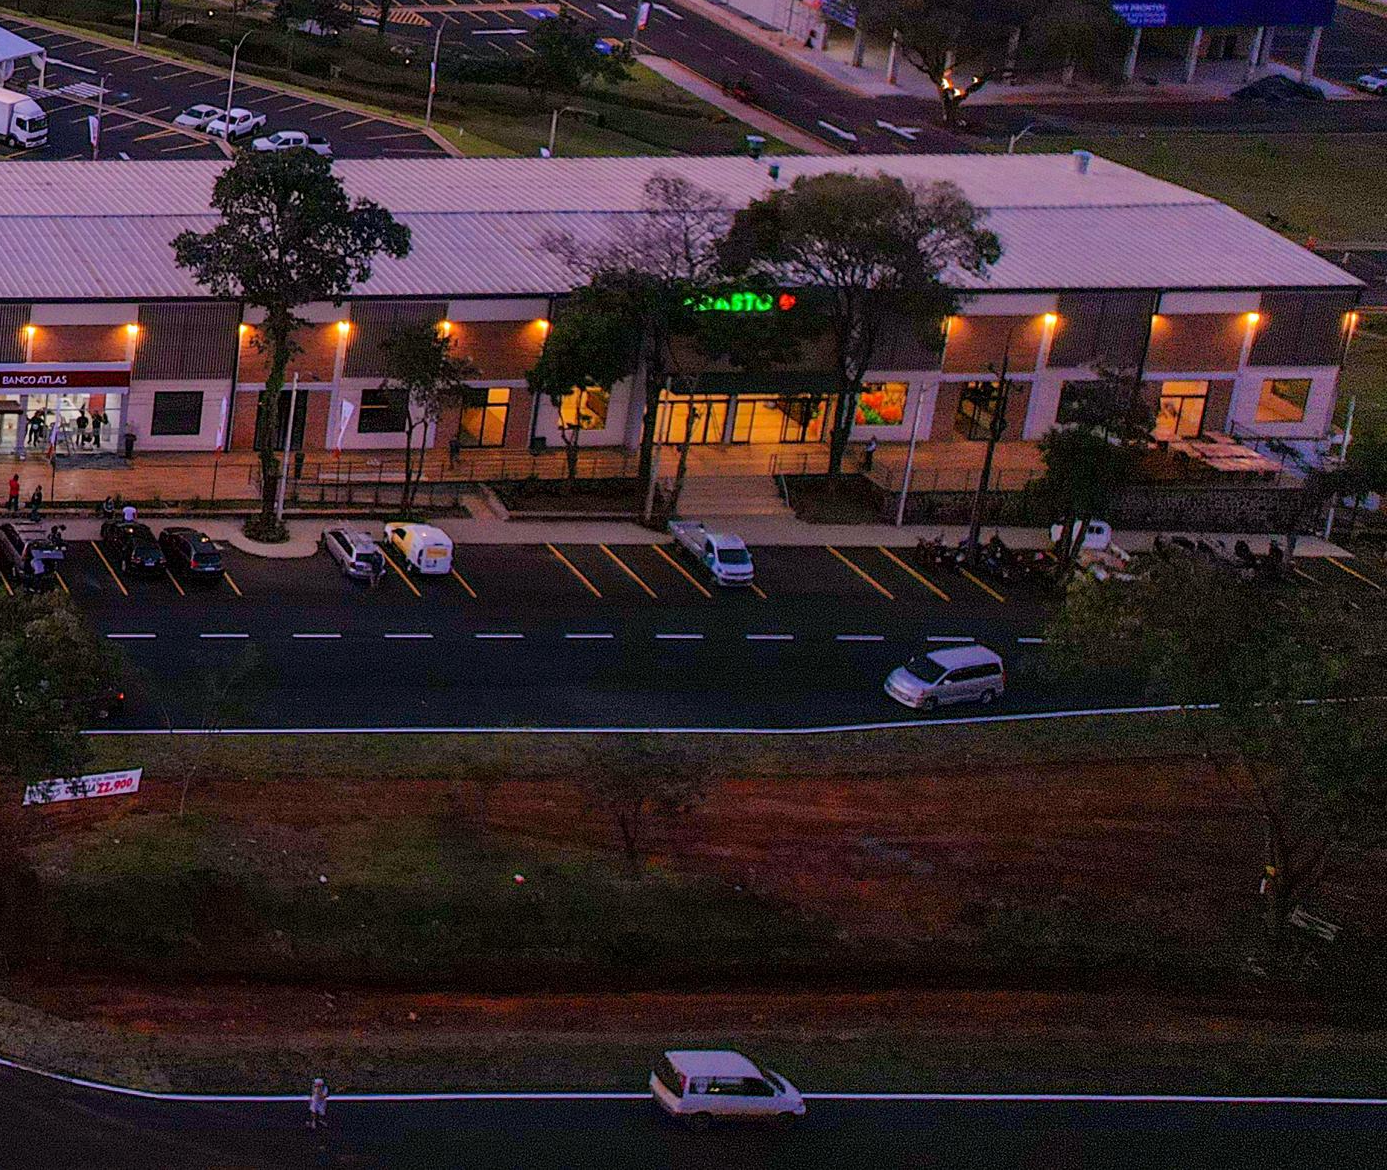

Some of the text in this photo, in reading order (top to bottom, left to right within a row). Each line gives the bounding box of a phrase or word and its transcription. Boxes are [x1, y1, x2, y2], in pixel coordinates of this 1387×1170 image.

[683, 292, 774, 311] ASTO
[2, 375, 67, 385] BANCO ATLAS
